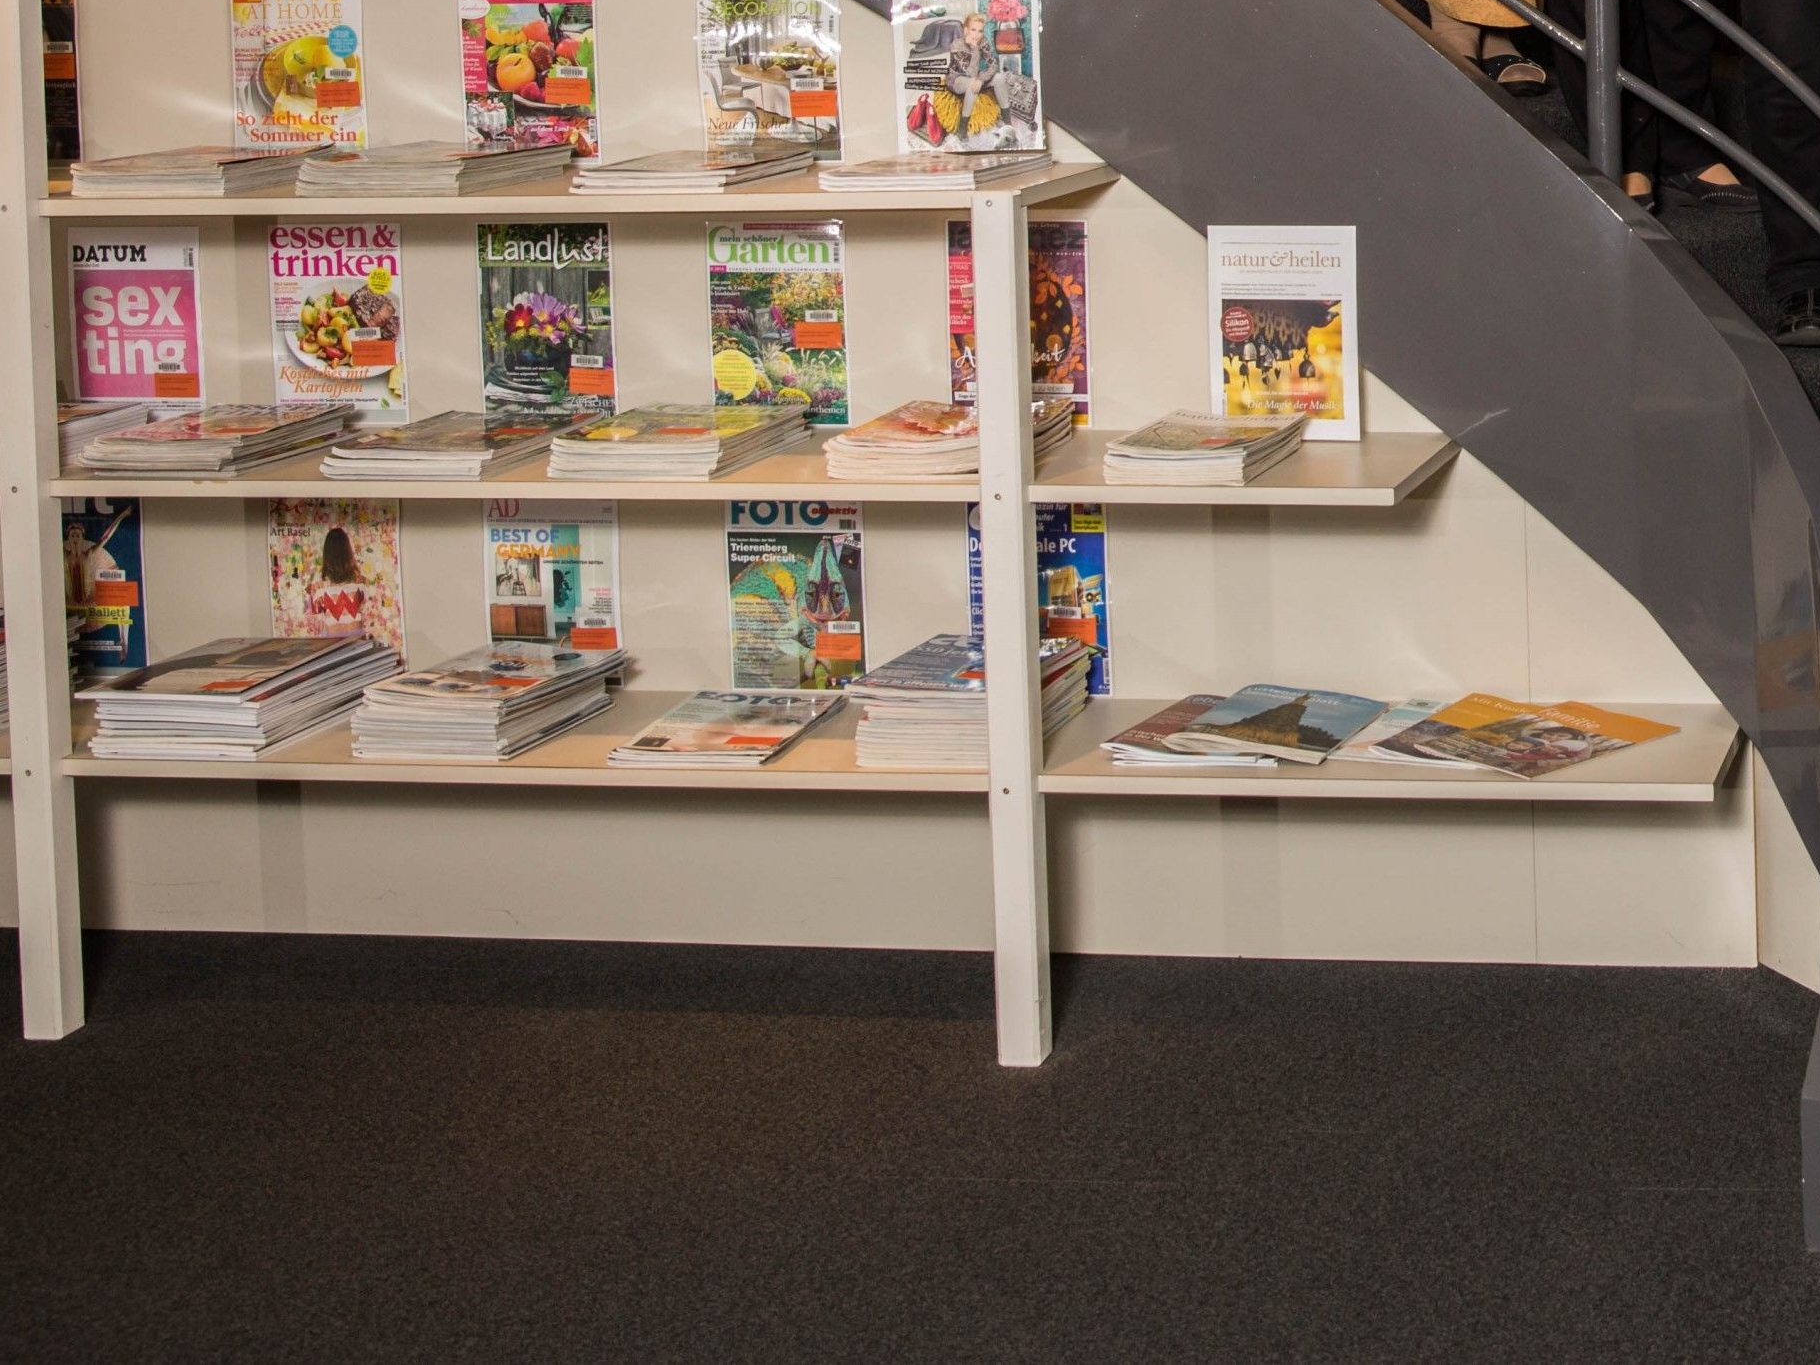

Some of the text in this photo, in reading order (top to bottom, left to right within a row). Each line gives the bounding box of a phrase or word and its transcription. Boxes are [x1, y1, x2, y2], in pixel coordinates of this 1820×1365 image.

[246, 3, 343, 19] AT HOME
[236, 110, 339, 126] So zieht der
[250, 127, 357, 142] Sommer ein
[269, 224, 399, 249] essen &
[719, 234, 778, 243] mein schöner
[707, 225, 830, 265] Garten
[72, 245, 147, 263] DATUM
[270, 249, 399, 277] trinken
[82, 285, 185, 327] sex
[1293, 400, 1307, 410] der
[1309, 400, 1338, 411] Musik
[488, 499, 520, 518] AD
[731, 501, 830, 526] FOTO
[270, 527, 311, 537] Art Basel
[490, 528, 560, 543] BEST OF
[496, 543, 582, 560] GERMANY
[731, 543, 788, 553] Trierenberg
[1059, 538, 1077, 554] PC
[731, 553, 796, 563] Super Circuit
